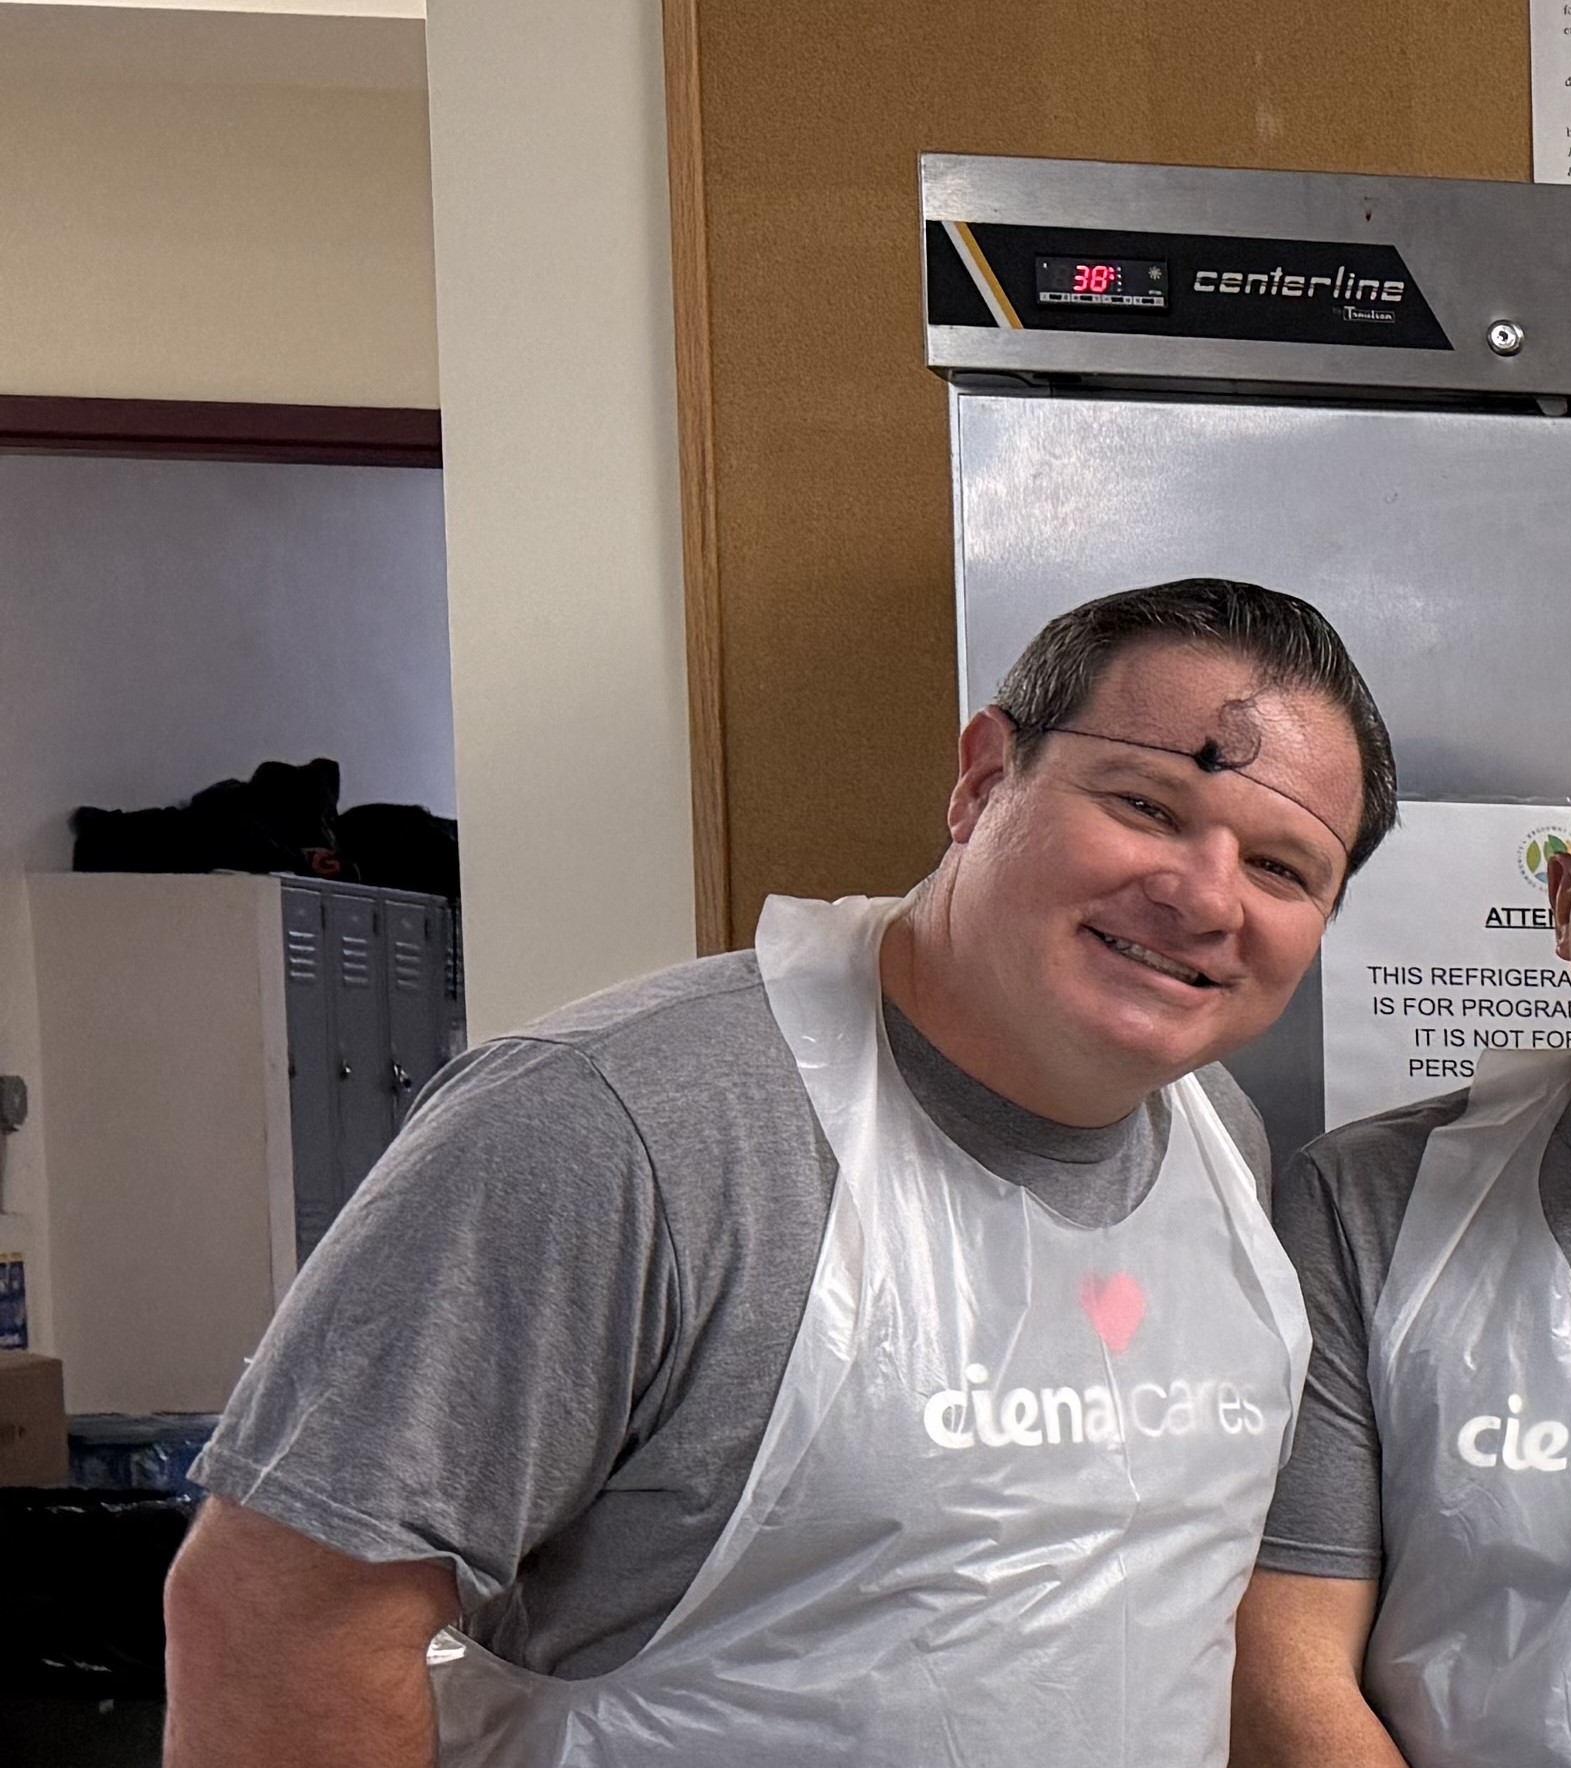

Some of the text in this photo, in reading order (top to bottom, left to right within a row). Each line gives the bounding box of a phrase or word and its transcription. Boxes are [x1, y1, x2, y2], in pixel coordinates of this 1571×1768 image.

[1194, 266, 1404, 302] centerline
[1367, 966, 1423, 985] THIS
[1373, 997, 1395, 1016] IS
[1403, 998, 1454, 1016] FOR
[1415, 1028, 1436, 1047] IT
[1444, 1028, 1465, 1047] IS
[1474, 1029, 1524, 1048] NOT
[1409, 1058, 1474, 1077] PERS
[923, 1362, 1265, 1450] ciena cares
